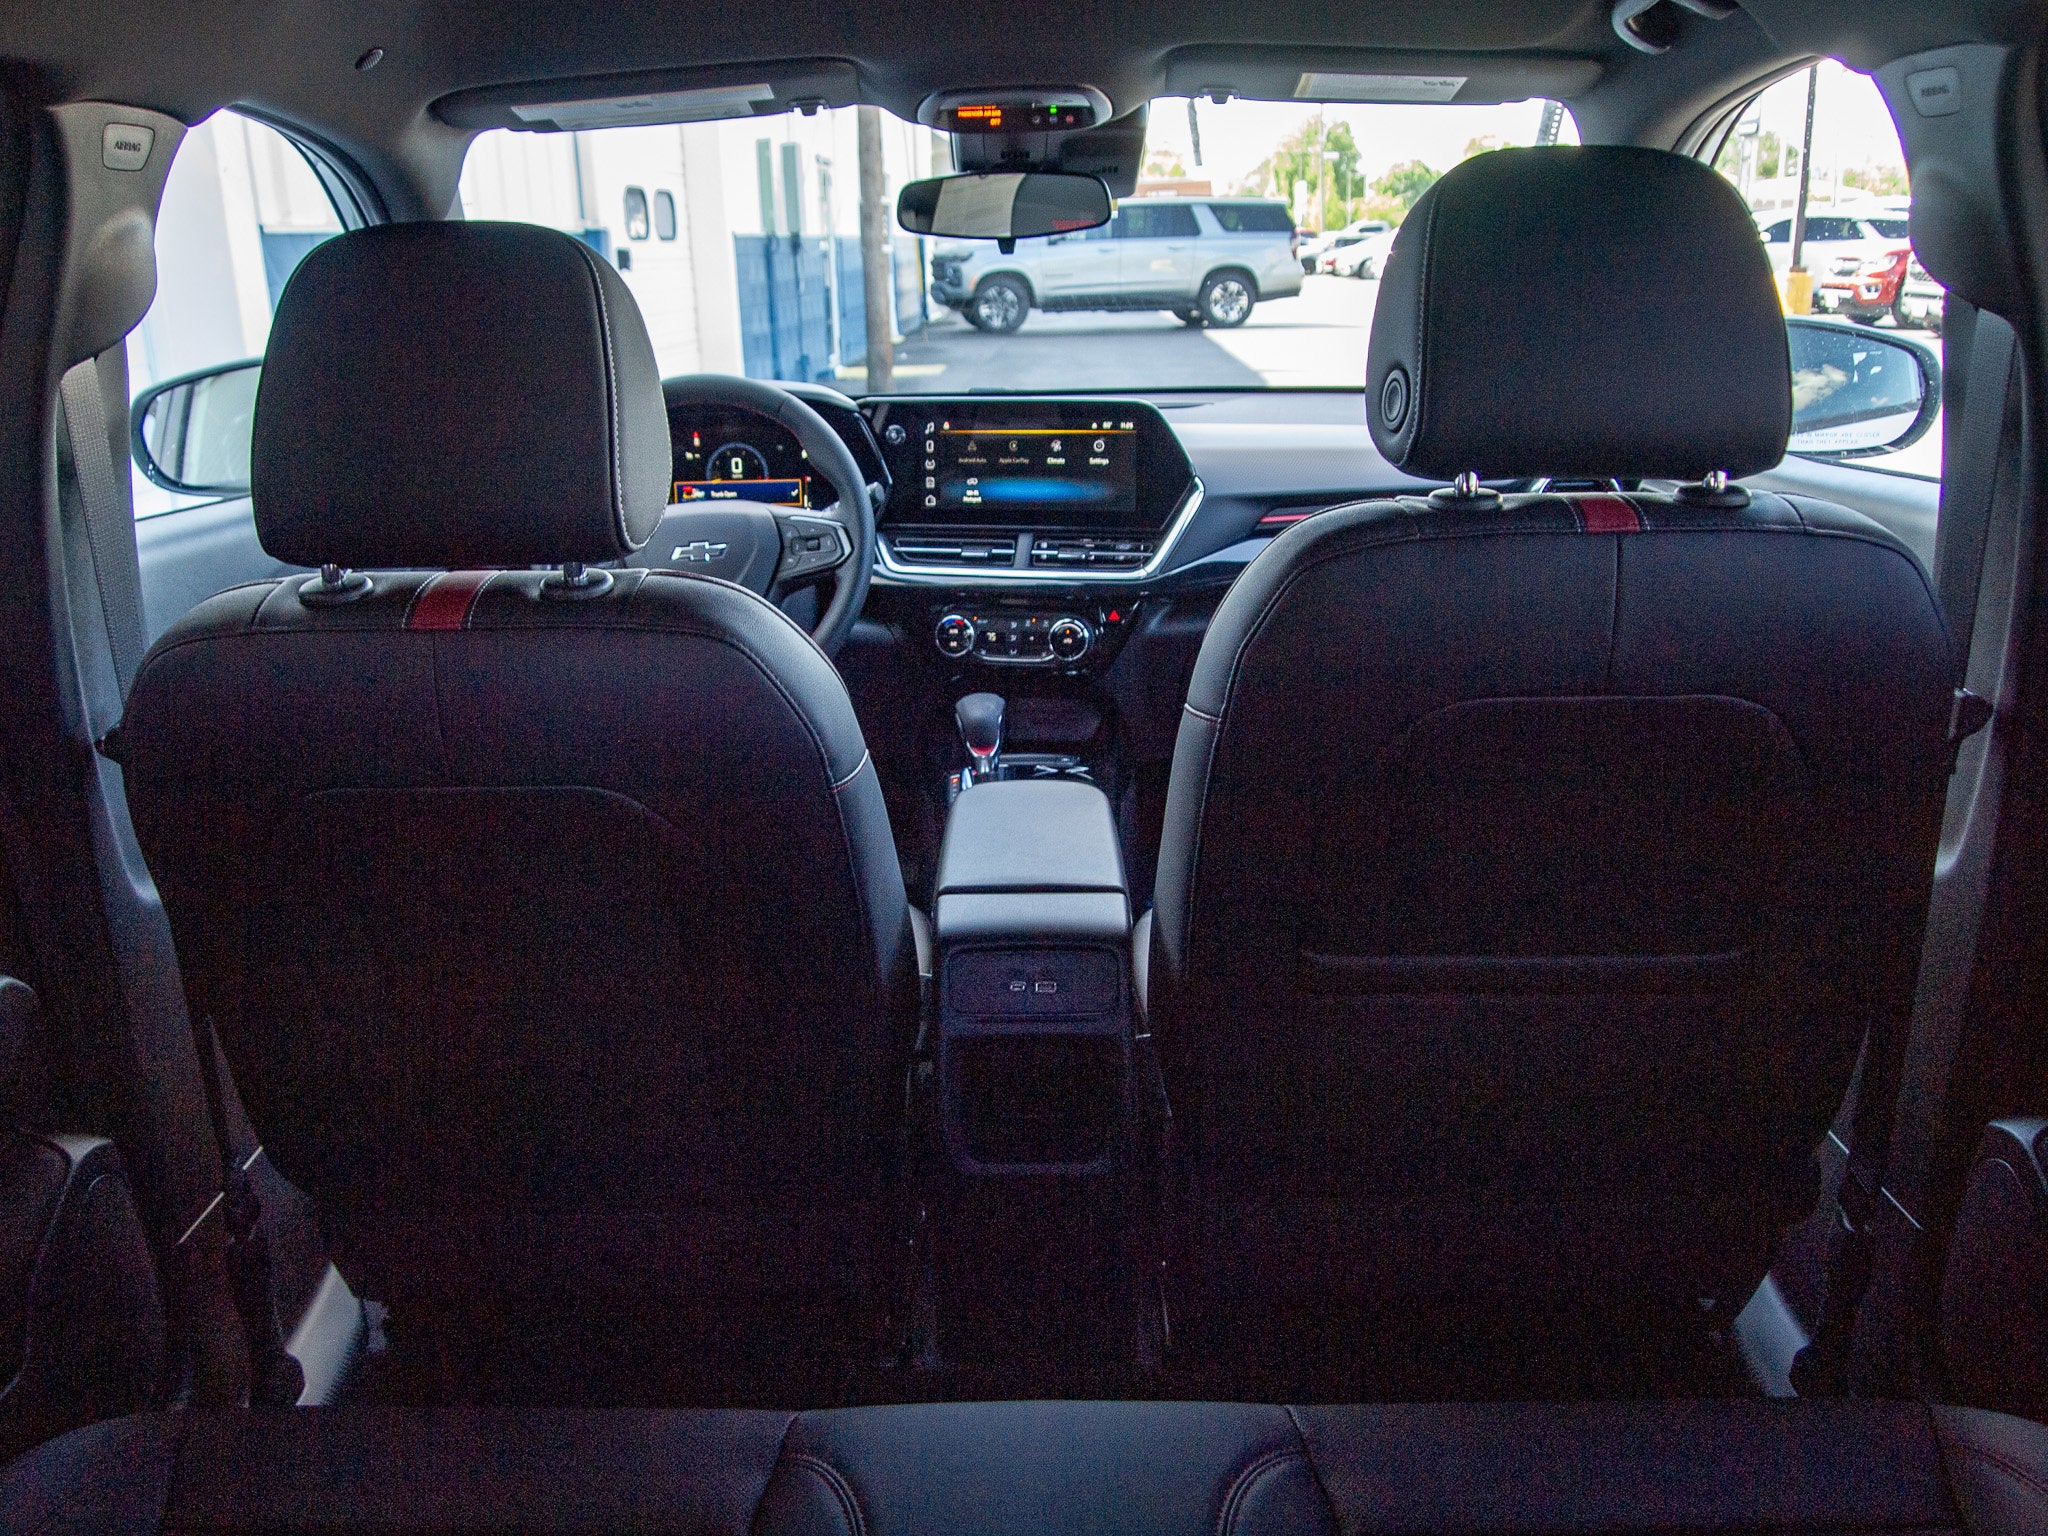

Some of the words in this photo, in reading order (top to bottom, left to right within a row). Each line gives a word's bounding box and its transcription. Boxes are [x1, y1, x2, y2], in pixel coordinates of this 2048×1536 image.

[990, 118, 1001, 126] OFF
[114, 140, 141, 152] AIRBAG
[731, 457, 742, 473] 0
[1089, 457, 1109, 466] Settings
